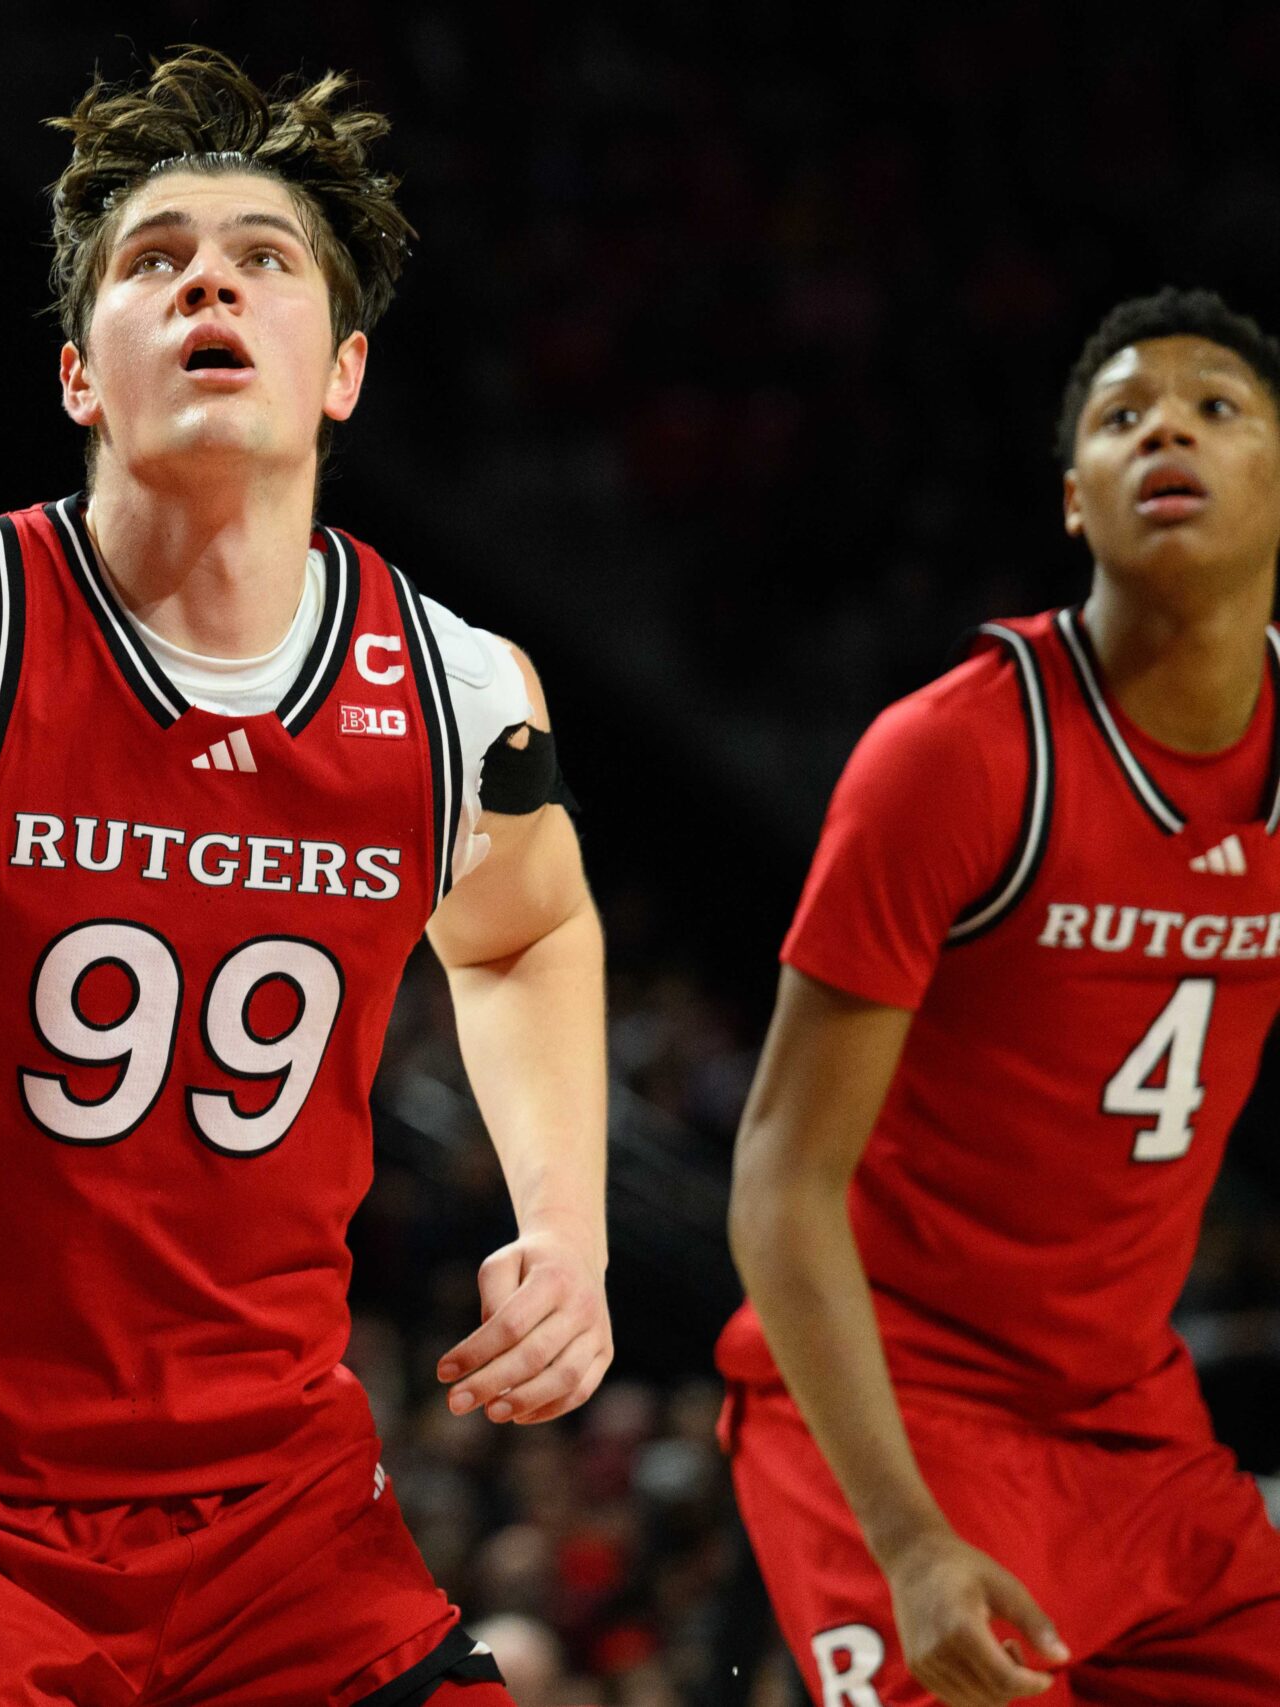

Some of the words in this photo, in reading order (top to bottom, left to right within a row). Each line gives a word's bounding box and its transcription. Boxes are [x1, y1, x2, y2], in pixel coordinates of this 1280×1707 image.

[354, 632, 405, 686] C
[9, 812, 402, 900] RUTGERS
[17, 917, 346, 1159] 99
[1100, 976, 1216, 1163] 4
[810, 1622, 885, 1707] R
